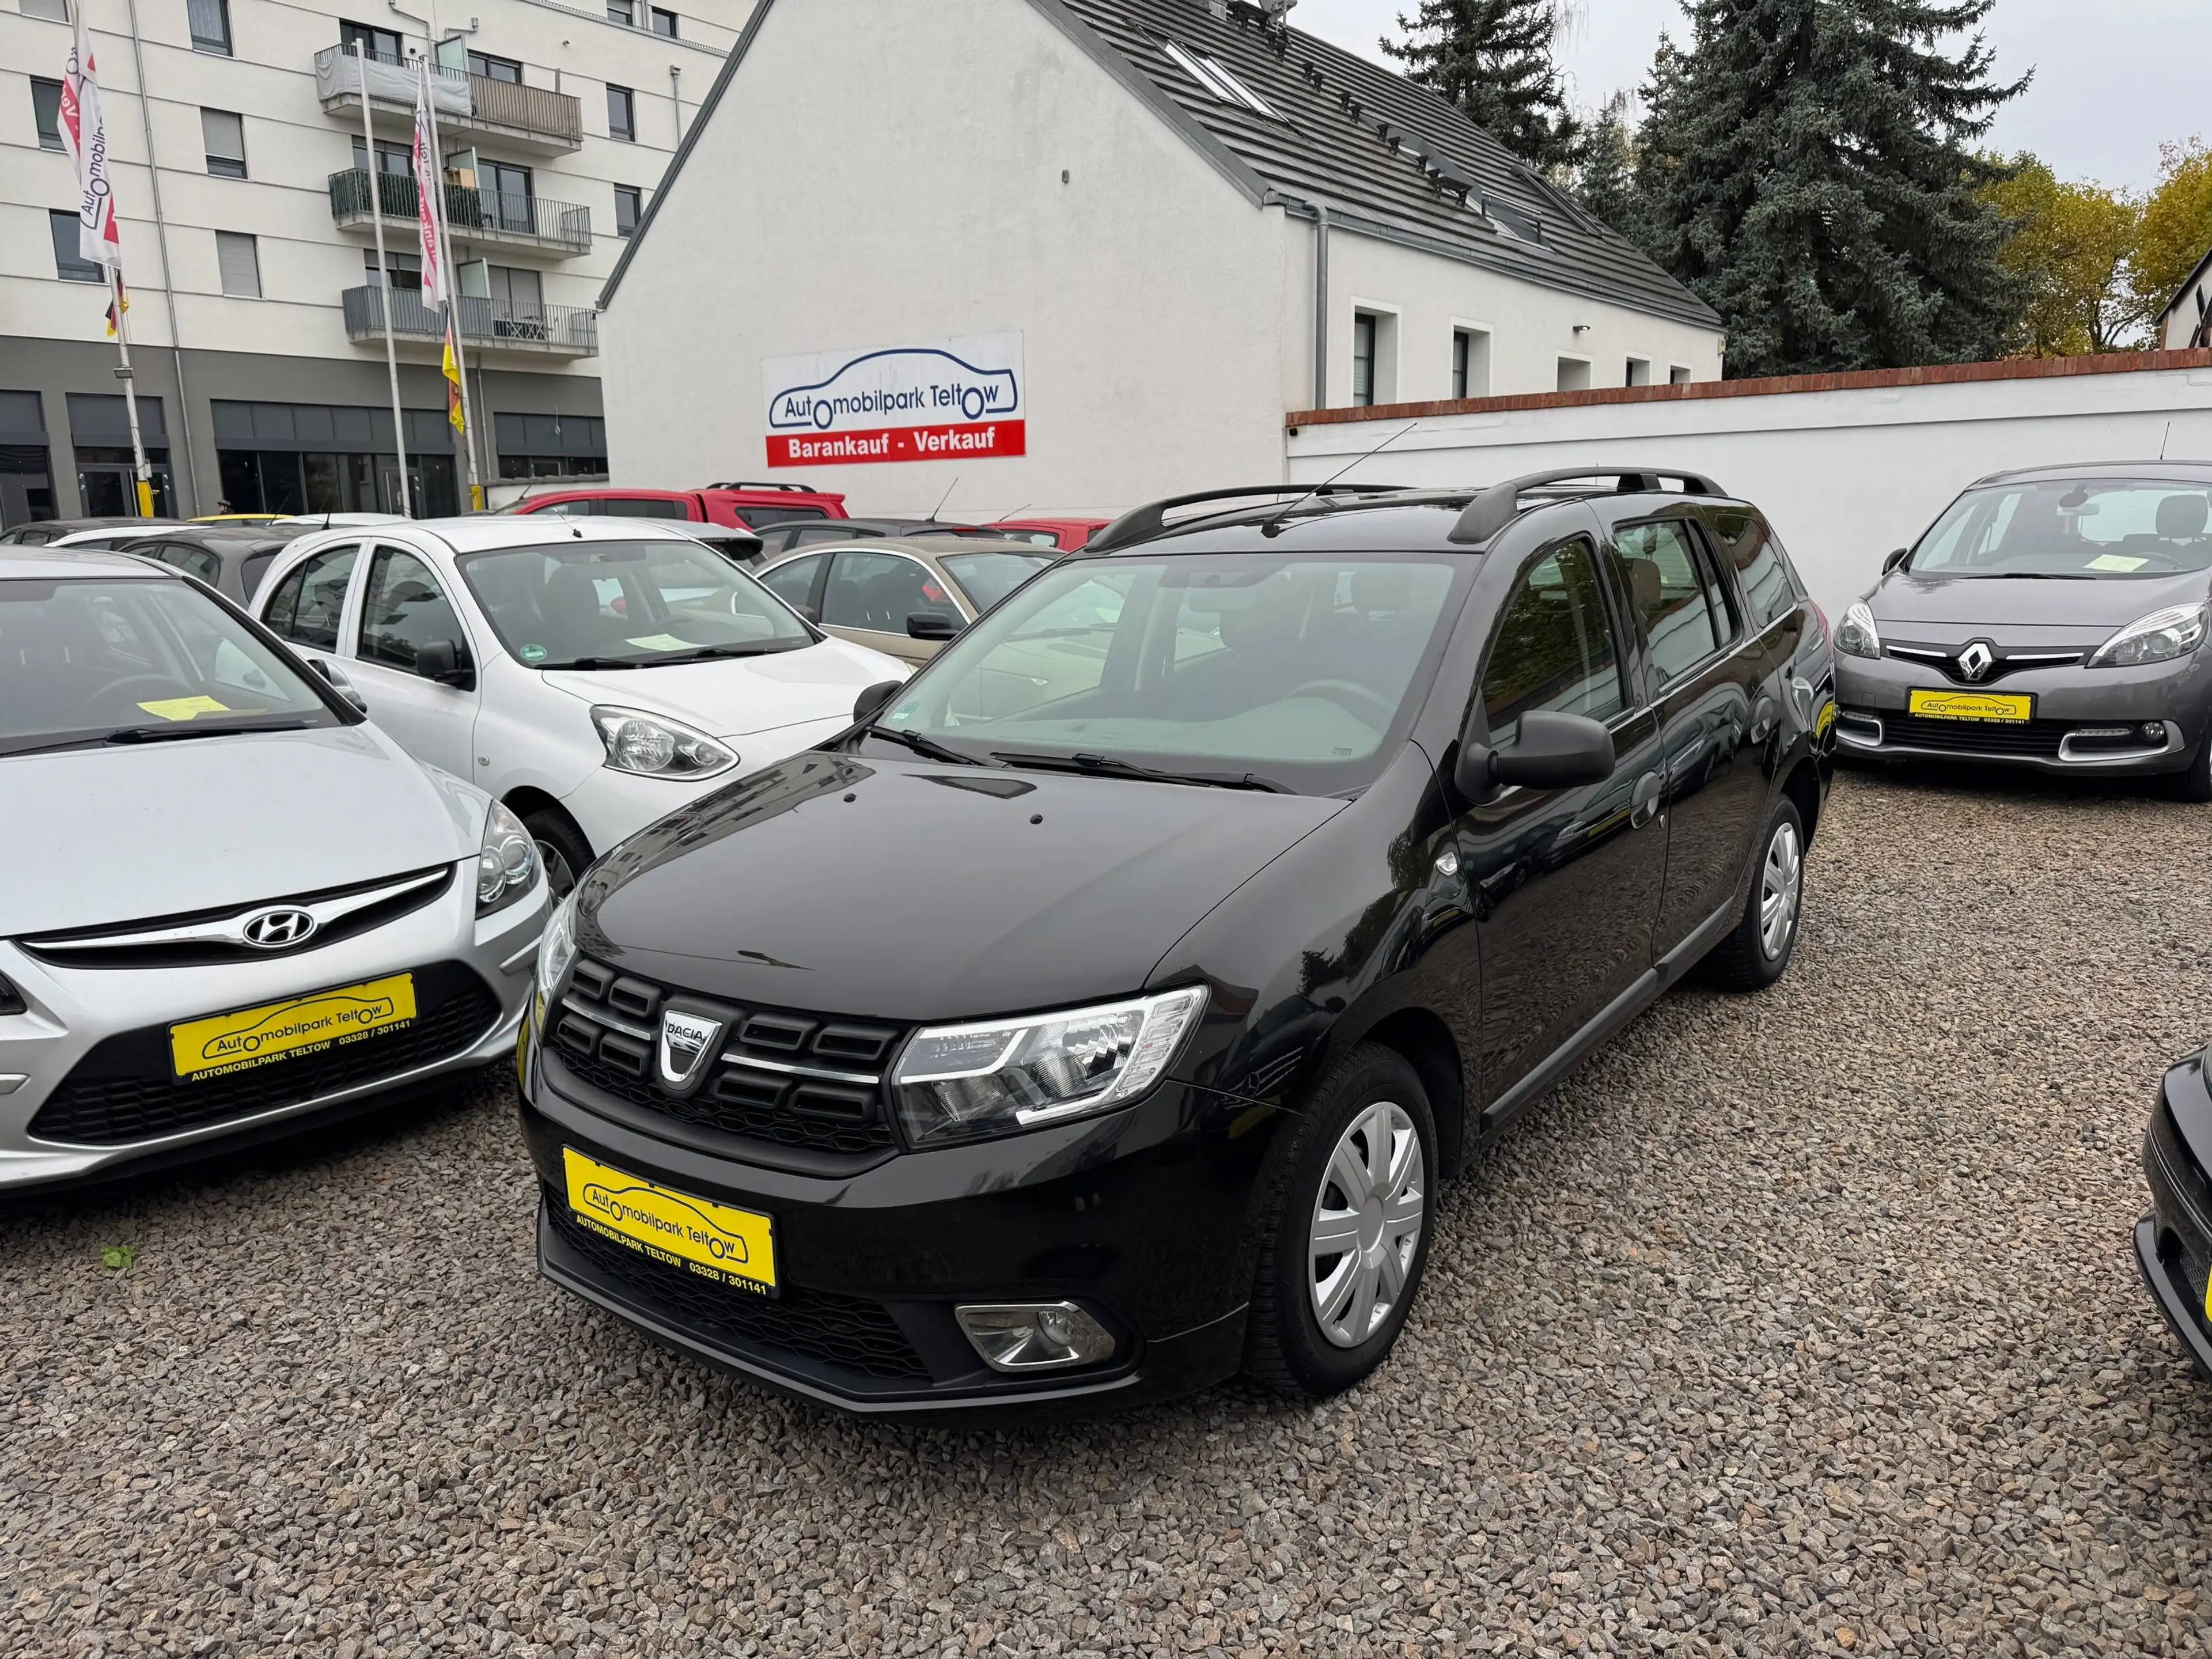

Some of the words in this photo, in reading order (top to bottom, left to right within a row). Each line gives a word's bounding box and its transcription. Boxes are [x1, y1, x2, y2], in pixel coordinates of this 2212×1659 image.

[788, 434, 889, 458] Barankauf
[913, 427, 995, 452] Verkauf
[192, 1051, 287, 1081] AUTOMOBILPARK
[289, 1041, 331, 1056] TELTOW
[339, 1031, 368, 1045] 03328
[377, 1020, 410, 1035] 301141
[667, 1023, 703, 1041] DACIA
[577, 1214, 644, 1253] AUTOMOBILPARK
[645, 1246, 681, 1267] TELTOW
[689, 1262, 719, 1281] 03328
[729, 1276, 767, 1295] 301141
